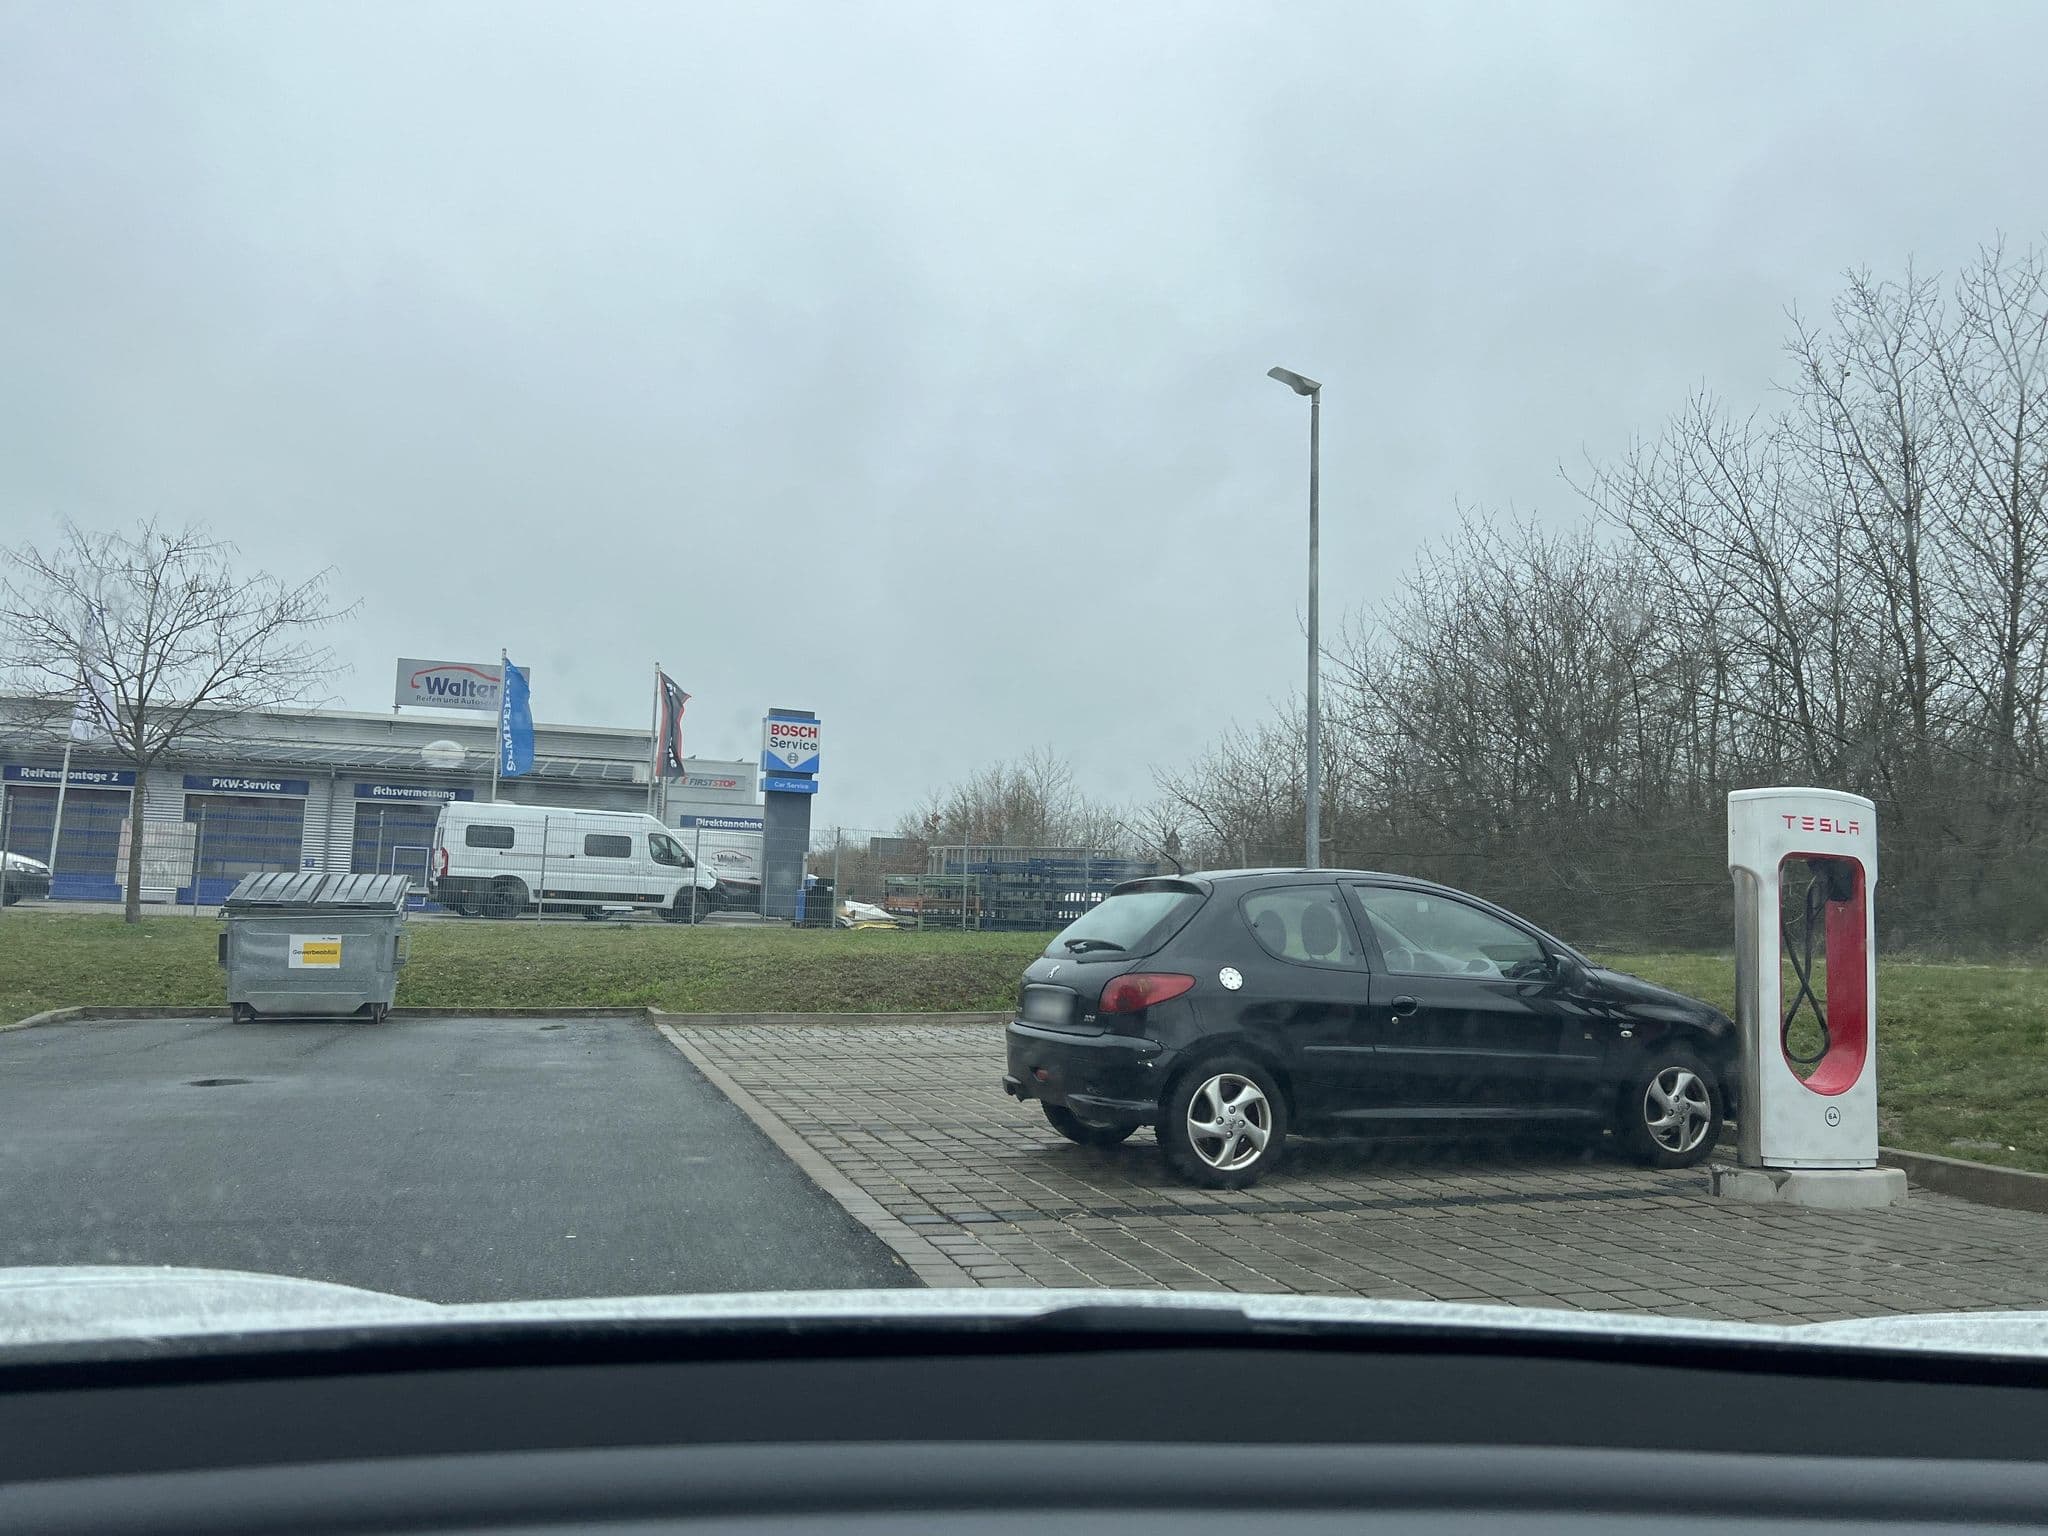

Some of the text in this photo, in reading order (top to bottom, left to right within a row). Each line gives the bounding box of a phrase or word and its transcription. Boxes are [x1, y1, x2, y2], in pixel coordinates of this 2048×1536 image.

[425, 676, 498, 698] Walter
[416, 695, 442, 703] Reifen
[771, 724, 817, 738] BOSCH
[770, 736, 818, 751] Service
[212, 778, 281, 790] PKW-Service
[786, 782, 809, 790] Service
[373, 786, 456, 800] Achsvermessung
[695, 818, 763, 829] Direktannahme
[1782, 815, 1859, 835] TESLA
